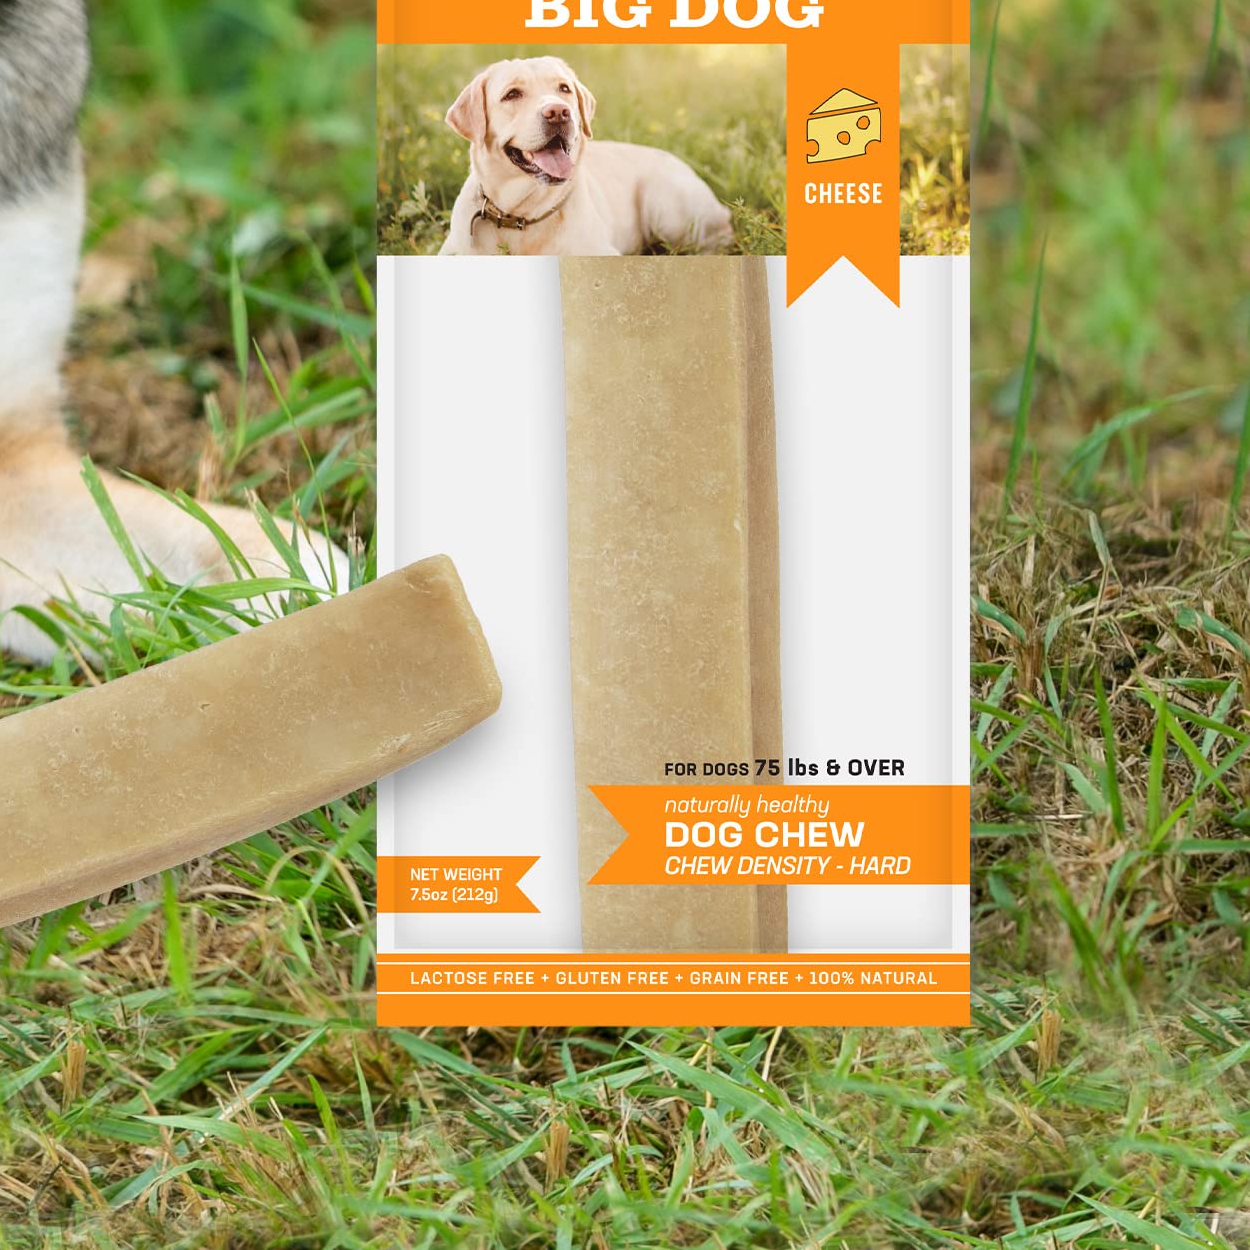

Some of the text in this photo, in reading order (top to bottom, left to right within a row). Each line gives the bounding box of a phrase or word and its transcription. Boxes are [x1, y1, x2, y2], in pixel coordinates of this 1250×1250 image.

[804, 182, 883, 205] CHEESE
[664, 757, 905, 777] FOR DOGS 75 lbs & OVER
[664, 793, 830, 819] naturally healthy
[665, 821, 865, 848] DOG CHEW
[410, 867, 503, 881] NET WEIGHT
[664, 855, 734, 875] CHEW
[737, 855, 832, 875] DENSITY
[849, 855, 912, 875] HARD
[410, 887, 448, 901] 7.5oz
[410, 971, 487, 985] LACTOSE
[493, 971, 535, 985] FREE
[555, 971, 621, 985] GLUTEN
[627, 971, 669, 985] FREE
[689, 971, 741, 985] GRAIN
[747, 971, 789, 985] FREE
[809, 971, 855, 985] 100%
[860, 971, 938, 985] NATURAL
